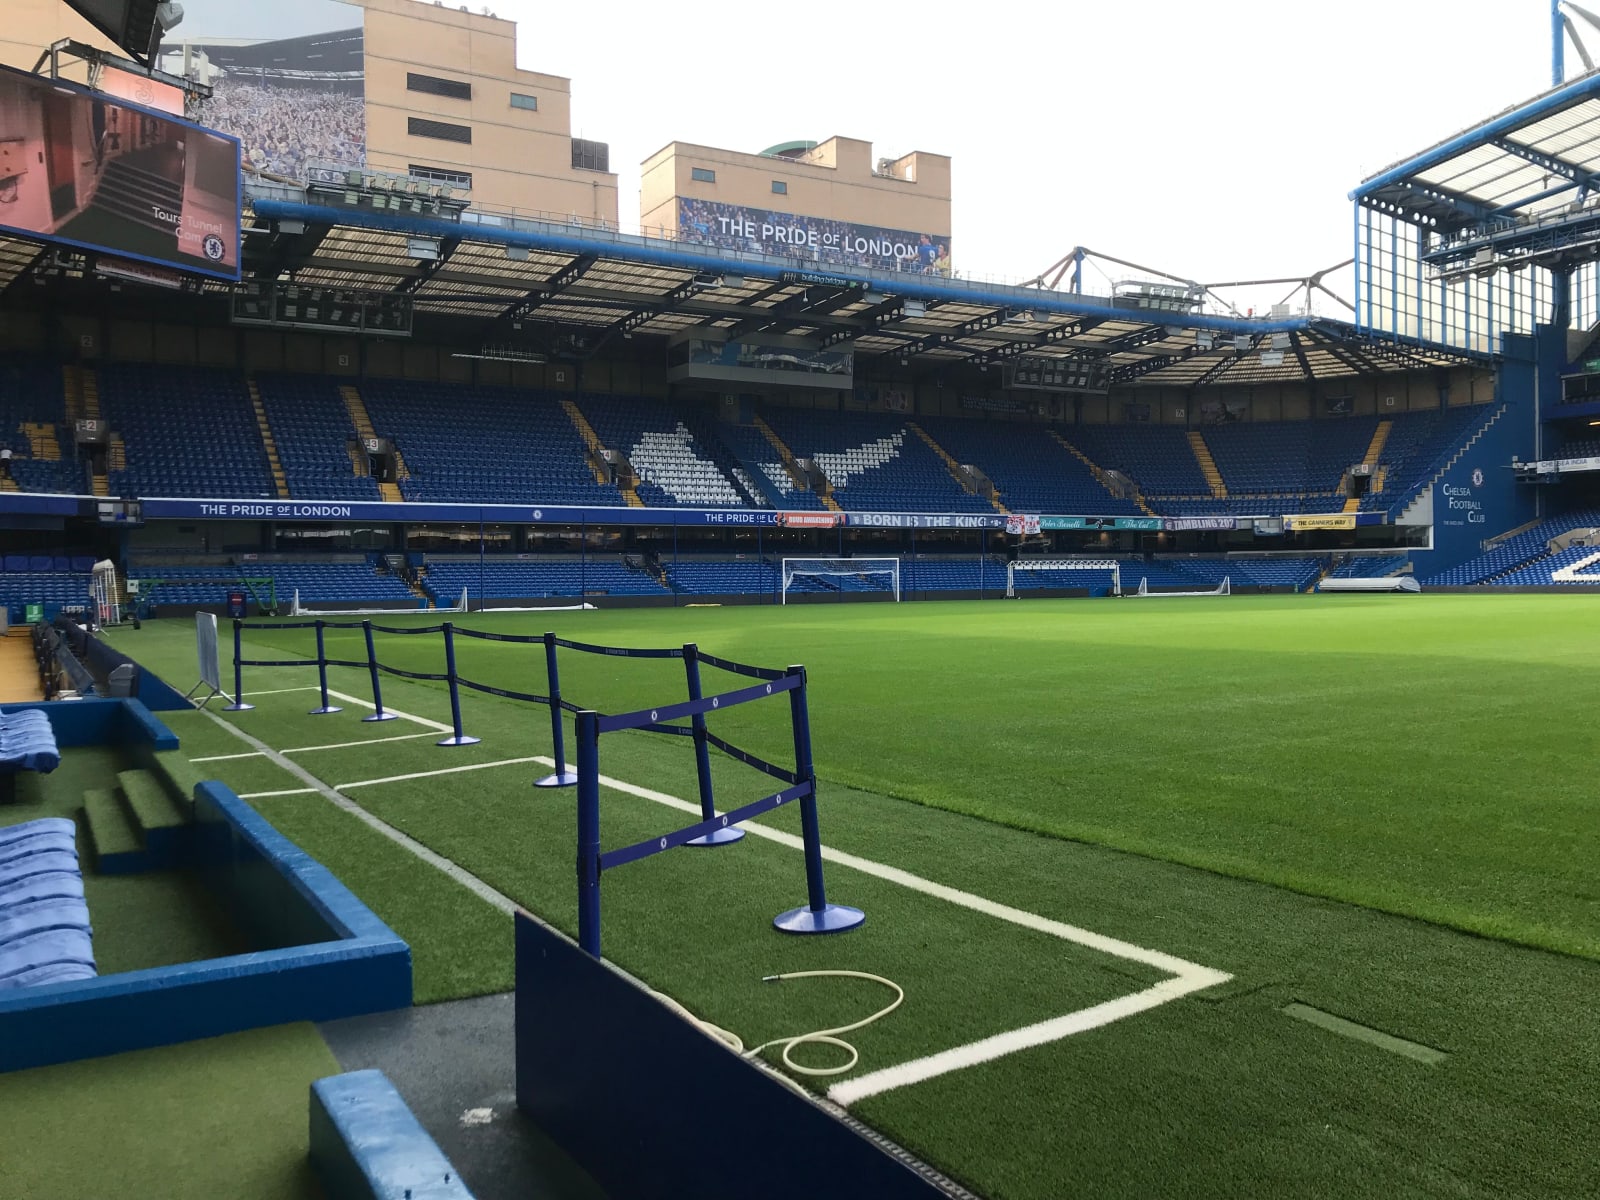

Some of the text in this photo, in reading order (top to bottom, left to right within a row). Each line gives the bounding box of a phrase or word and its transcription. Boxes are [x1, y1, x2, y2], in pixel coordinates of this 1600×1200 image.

[152, 206, 223, 234] Tours Tunnel
[718, 217, 918, 259] THE PRIDE OF LONDON
[88, 421, 96, 430] 2
[1541, 460, 1570, 468] CHESEA
[1443, 483, 1471, 496] CHELSEA
[1449, 497, 1482, 510] FOOTBALL
[200, 504, 351, 517] THE PRIDE OF LONDON
[1467, 511, 1485, 523] CLUB
[705, 513, 724, 522] THE
[727, 514, 755, 523] PRIDE
[757, 514, 766, 522] OF
[863, 514, 987, 527] BORN IS THE KING
[1174, 518, 1217, 530] TAMBLING
